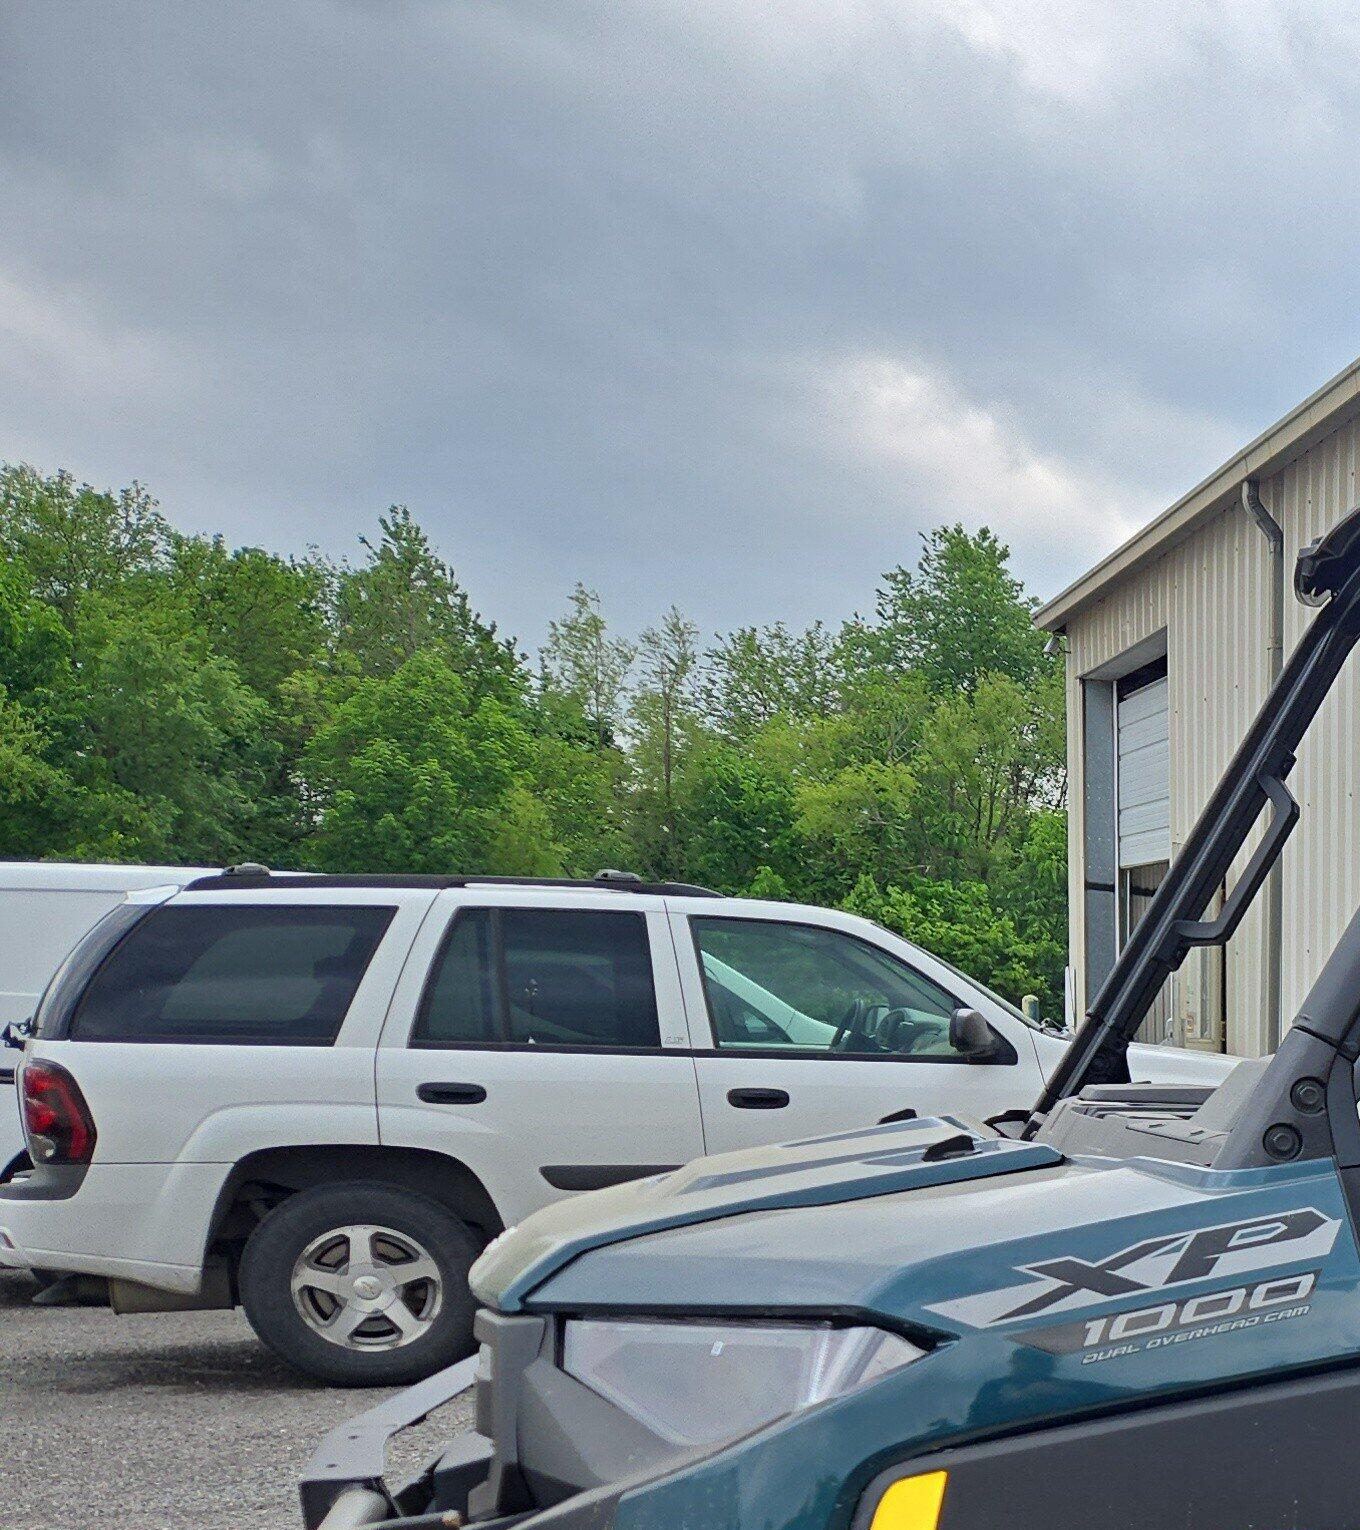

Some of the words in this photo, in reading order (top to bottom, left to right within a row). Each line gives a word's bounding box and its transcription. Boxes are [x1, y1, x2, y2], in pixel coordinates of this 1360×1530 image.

[988, 1207, 1334, 1327] XP
[1081, 1344, 1140, 1365] DUAL
[1146, 1316, 1260, 1349] OVERHEAD
[1264, 1304, 1312, 1323] CAM
[1083, 1273, 1315, 1347] 1000
